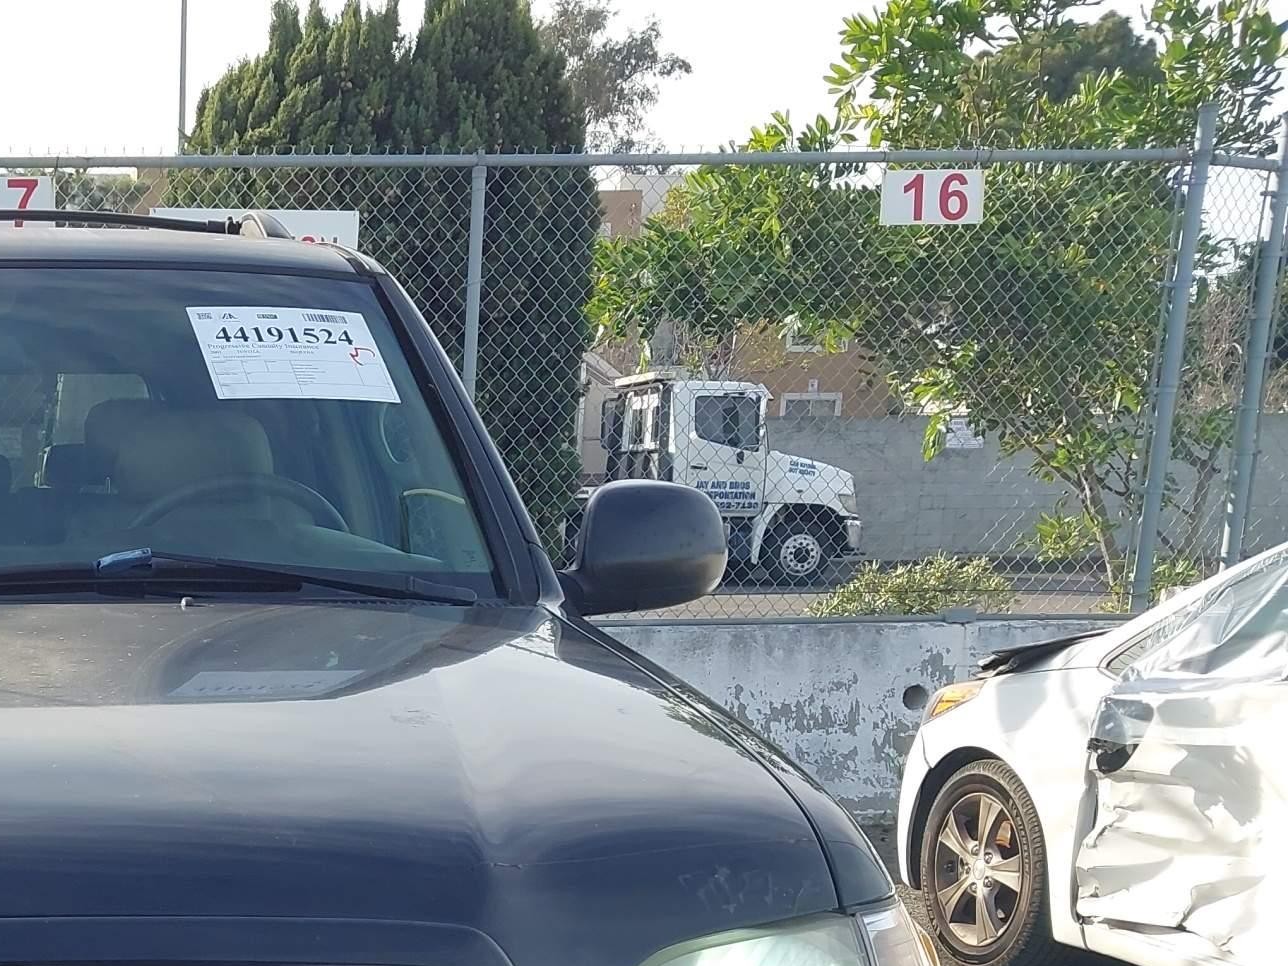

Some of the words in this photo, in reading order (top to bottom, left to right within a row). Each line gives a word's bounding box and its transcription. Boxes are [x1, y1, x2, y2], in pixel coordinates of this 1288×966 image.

[903, 172, 969, 222] 16
[215, 326, 354, 346] 44191524
[695, 480, 709, 489] JAY
[710, 480, 728, 489] AND
[729, 481, 751, 490] BROS
